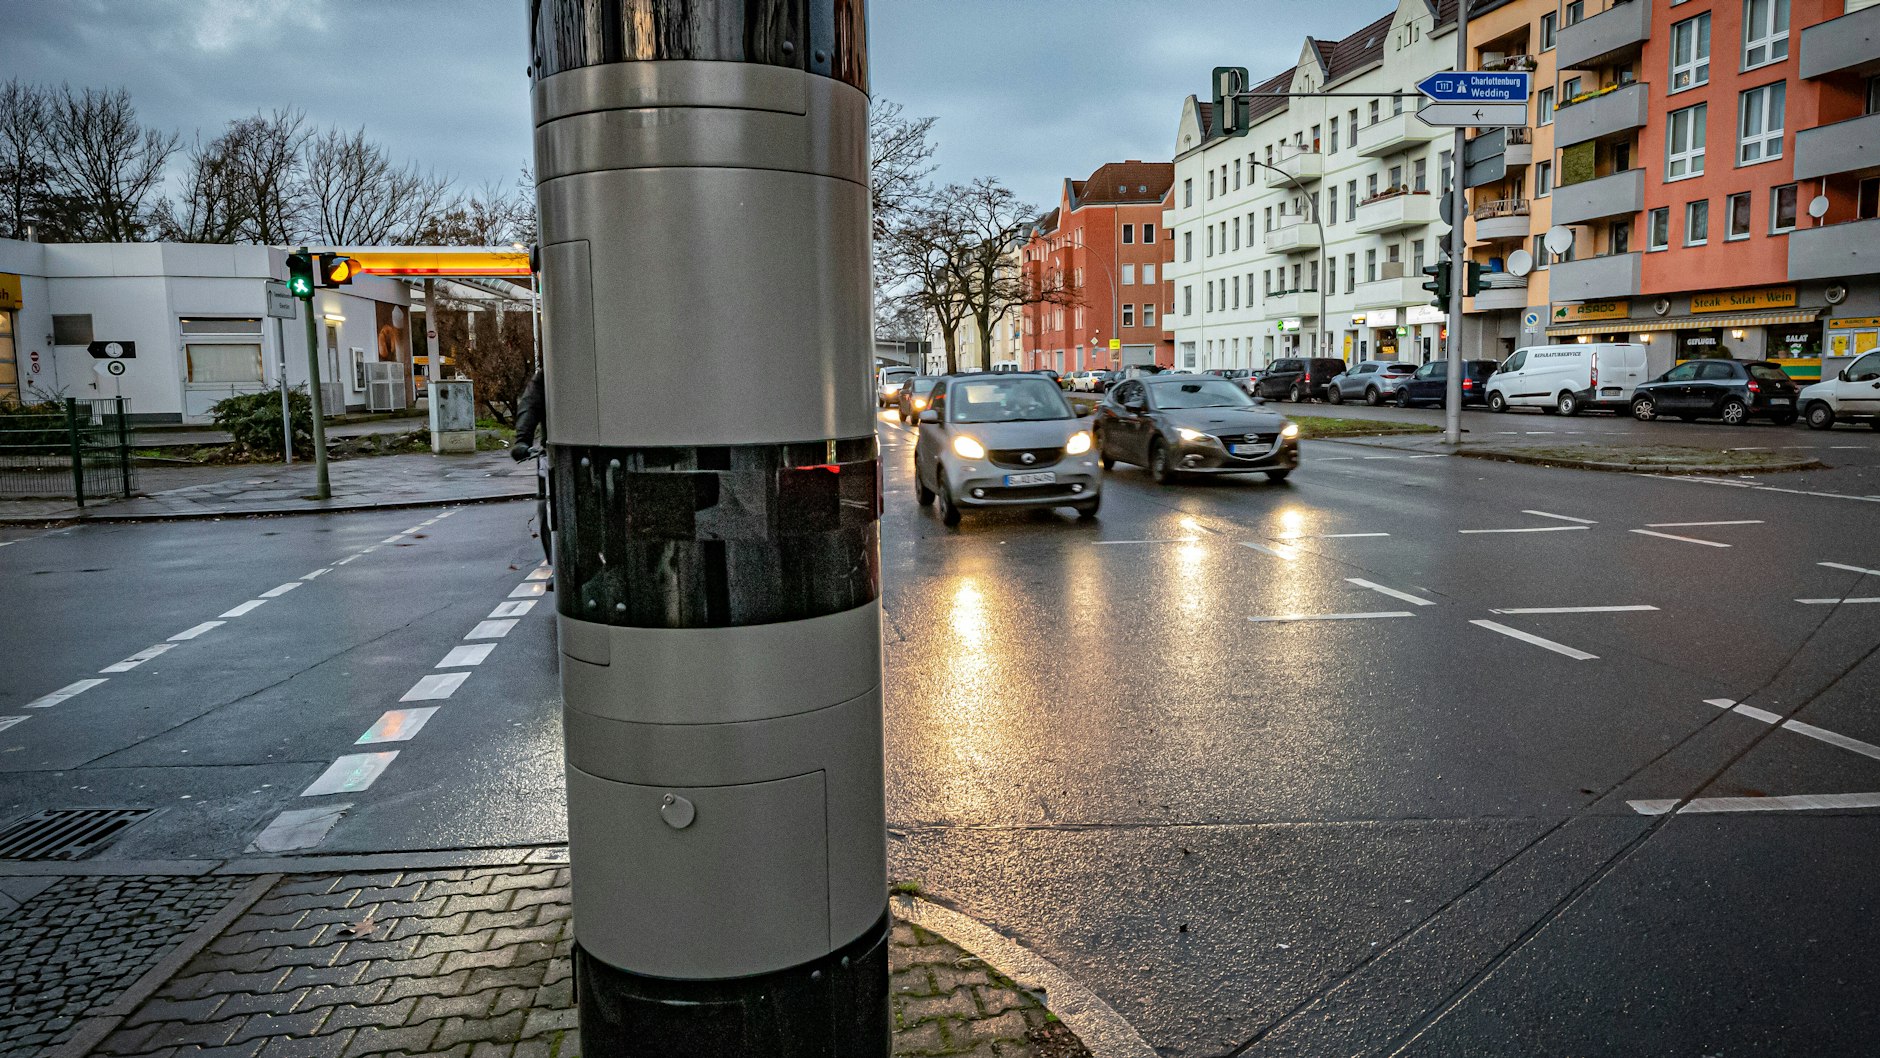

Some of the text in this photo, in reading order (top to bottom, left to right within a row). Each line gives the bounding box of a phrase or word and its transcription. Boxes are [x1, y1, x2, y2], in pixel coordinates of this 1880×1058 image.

[1470, 76, 1520, 87] Charlottenburg
[1471, 88, 1510, 99] Wedding
[1694, 291, 1792, 307] Steak Salat Wein
[1578, 304, 1616, 314] ASADO
[1786, 334, 1808, 342] SALAT
